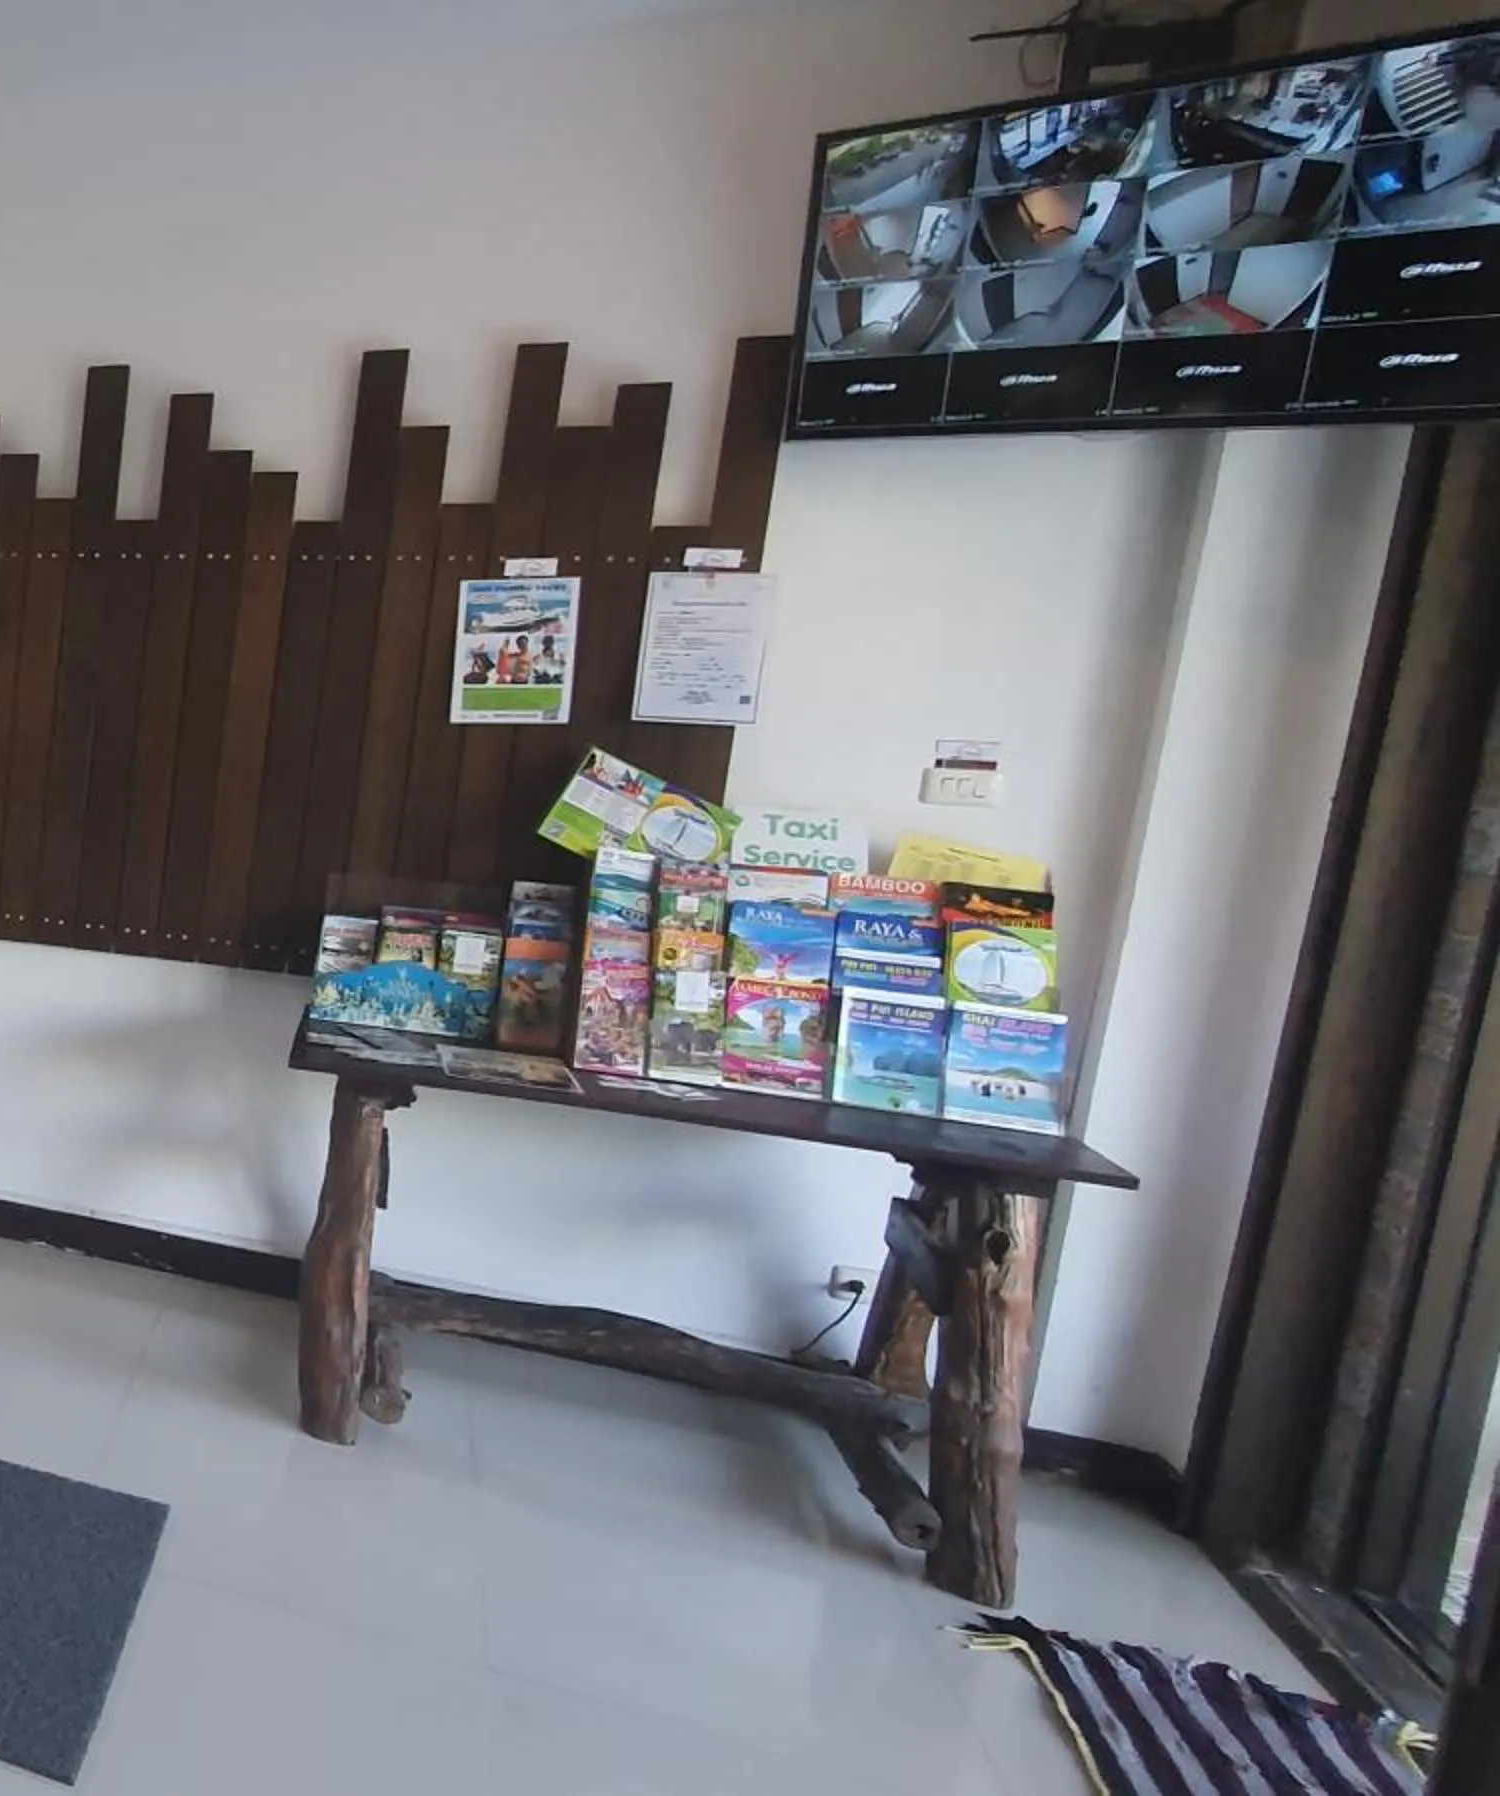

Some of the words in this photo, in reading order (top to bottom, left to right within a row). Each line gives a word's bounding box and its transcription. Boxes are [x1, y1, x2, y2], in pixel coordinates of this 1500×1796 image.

[762, 813, 839, 842] Taxi
[744, 843, 856, 873] Service
[837, 873, 926, 895] BAMBOO
[745, 907, 784, 926] RAYA
[854, 919, 905, 938] RAYA
